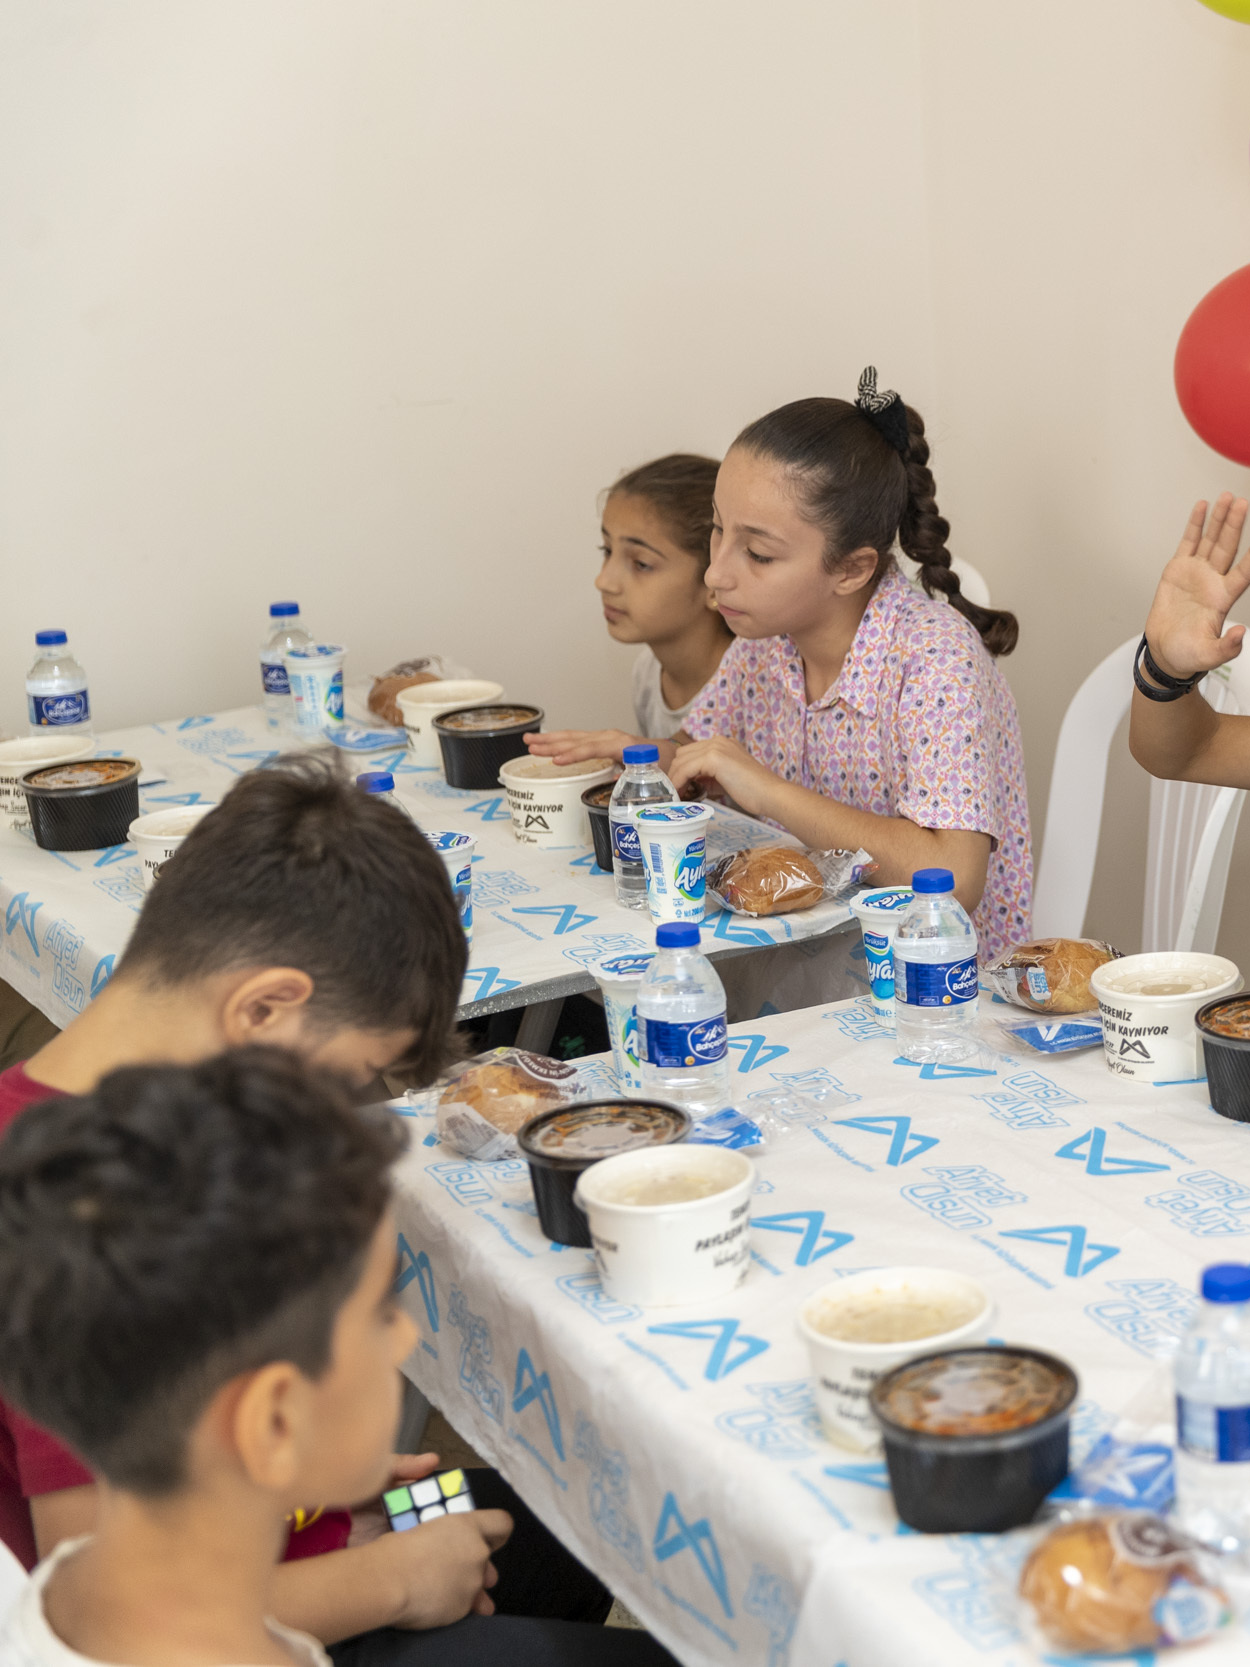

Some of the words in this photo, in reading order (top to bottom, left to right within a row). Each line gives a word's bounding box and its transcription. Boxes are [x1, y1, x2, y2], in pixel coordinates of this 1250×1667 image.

[523, 803, 563, 813] KAYNIYOR
[866, 954, 894, 984] yra
[1118, 1025, 1169, 1038] KAYNIYOR
[934, 1167, 1015, 1206] Afiyet
[909, 1185, 984, 1228] Olsun
